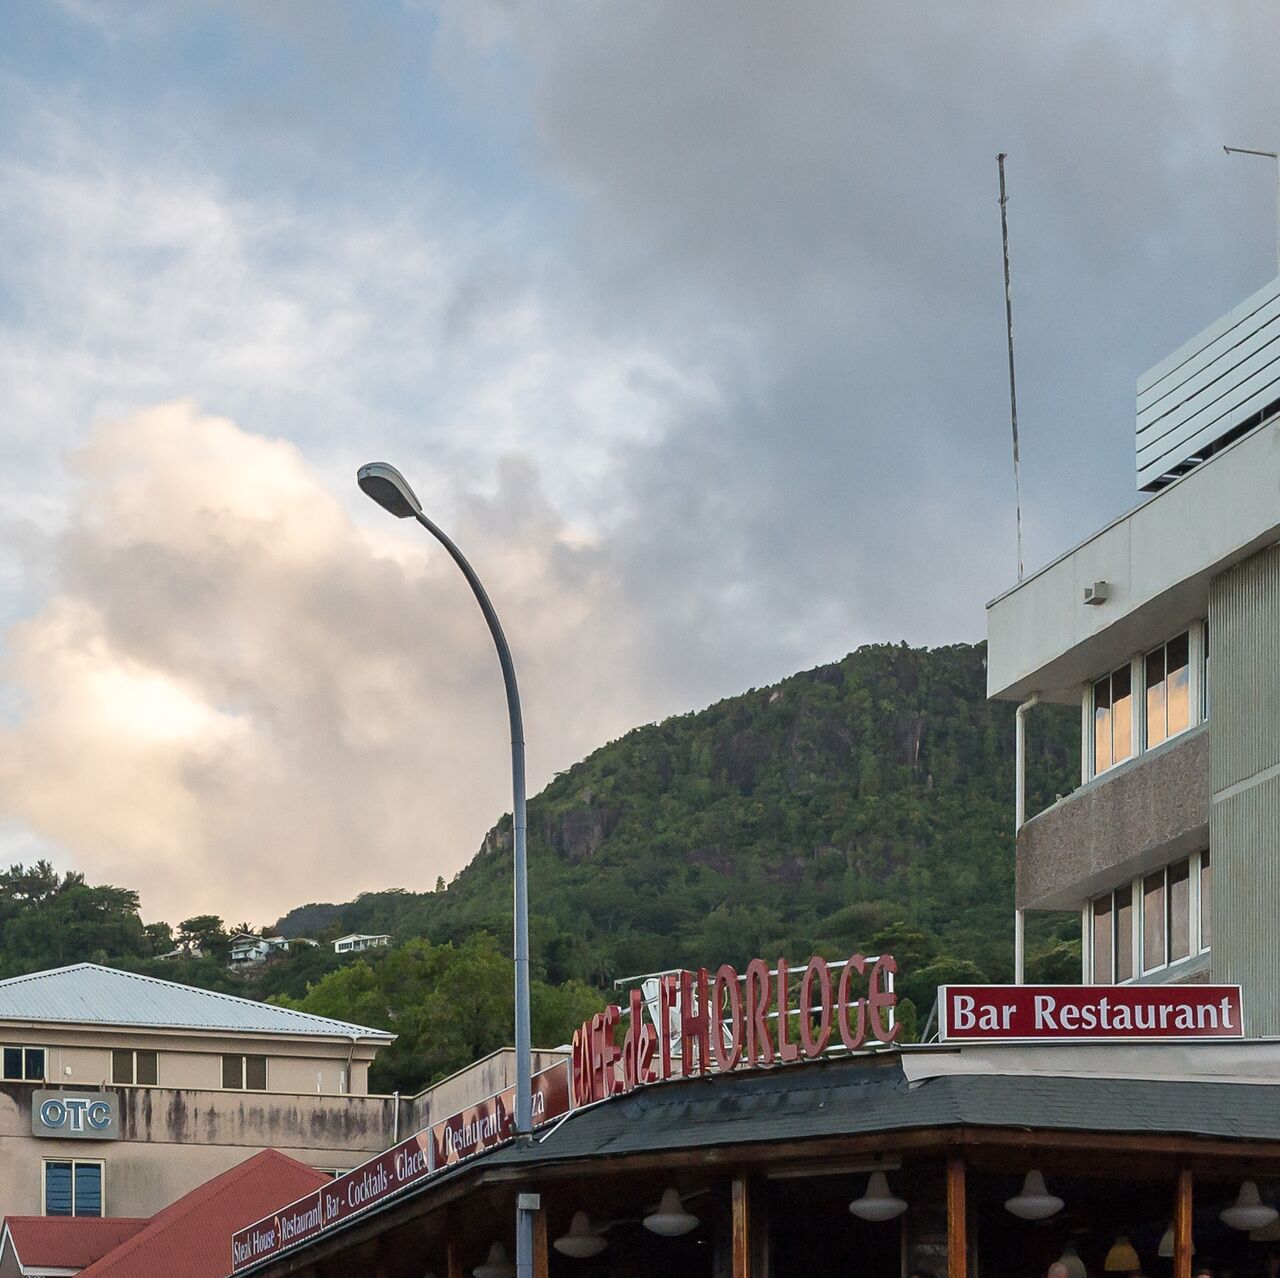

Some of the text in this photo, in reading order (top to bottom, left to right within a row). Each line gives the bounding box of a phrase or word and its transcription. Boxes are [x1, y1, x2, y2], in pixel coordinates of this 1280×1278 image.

[953, 995, 1233, 1030] Bar Restaurant
[40, 1098, 112, 1131] OTC
[445, 1104, 502, 1156] Restaurant
[234, 1233, 253, 1265] Steak
[253, 1230, 276, 1256] House
[281, 1201, 322, 1241] Restaurant
[326, 1194, 340, 1220] Bar
[348, 1163, 388, 1208] Cocktails
